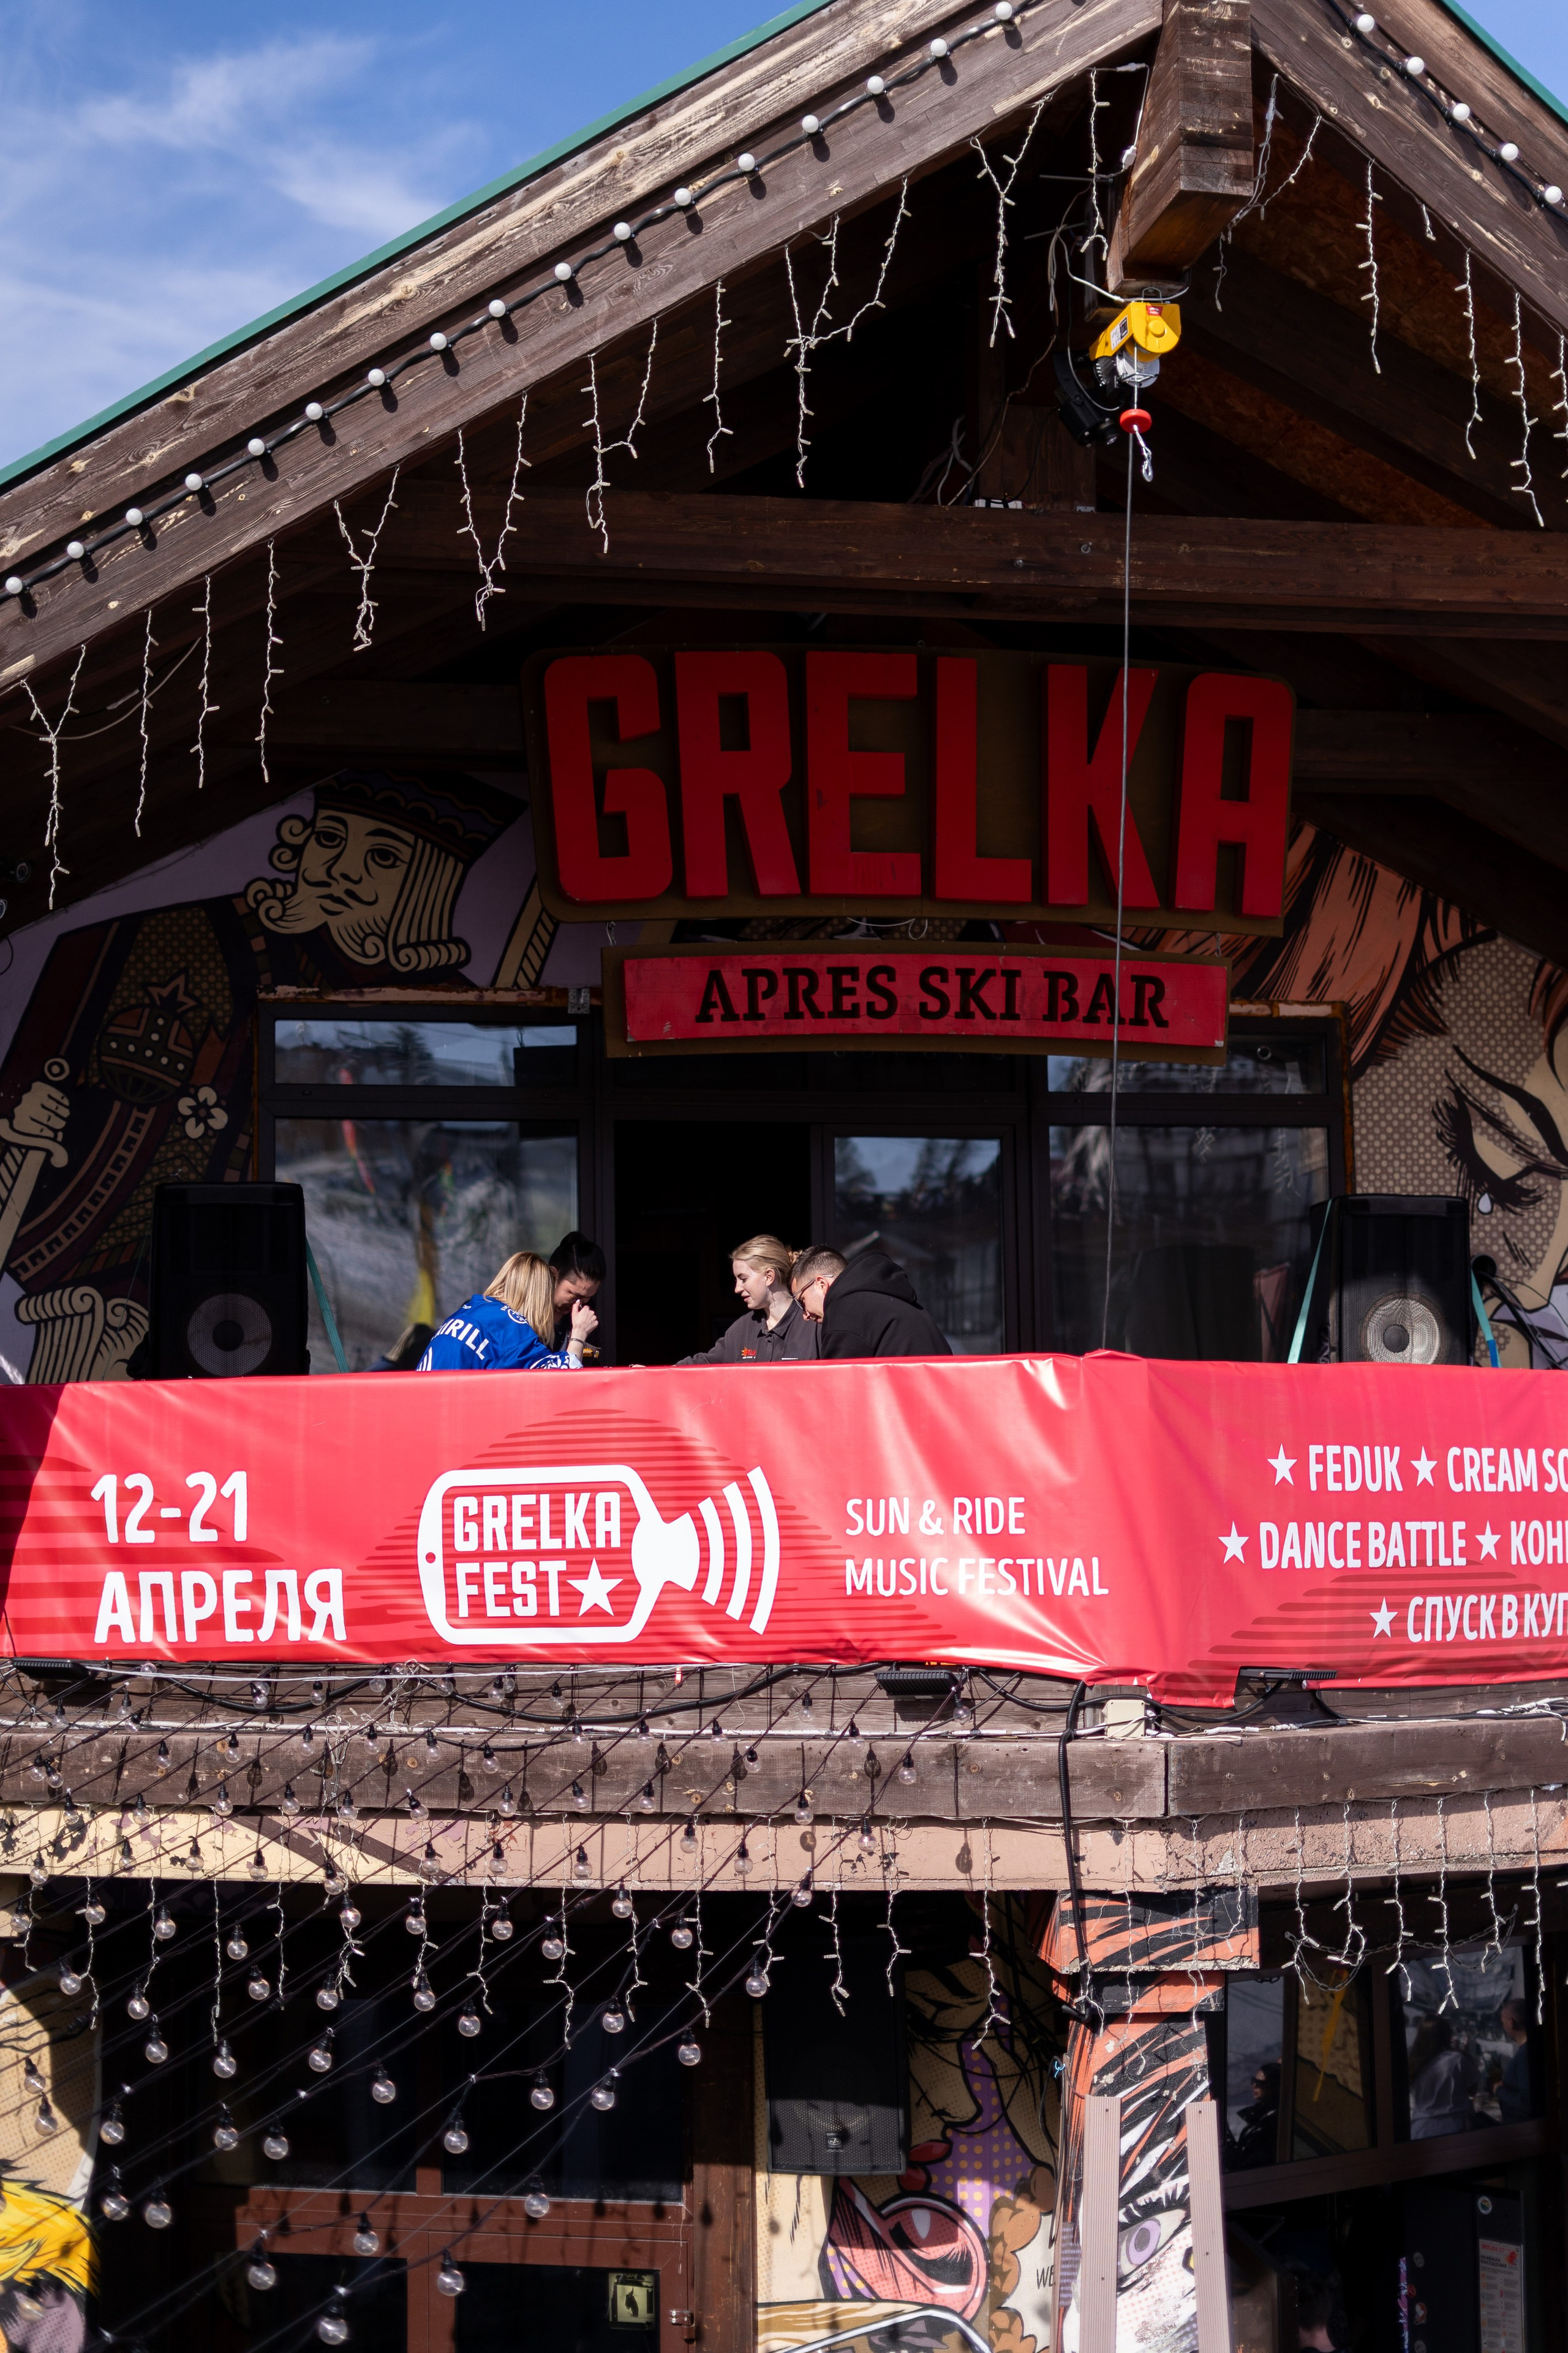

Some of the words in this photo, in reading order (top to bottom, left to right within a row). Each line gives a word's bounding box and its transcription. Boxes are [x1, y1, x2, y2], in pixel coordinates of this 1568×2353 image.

[544, 651, 1292, 918] GRELKA
[695, 966, 899, 1023] APRES
[919, 967, 1021, 1021] SKI
[1043, 971, 1169, 1028] BAR
[1309, 1445, 1403, 1492] FEDUK
[1447, 1447, 1538, 1492] CREAM
[91, 1471, 247, 1544] 12-21
[454, 1492, 621, 1552] GRELKA
[845, 1497, 910, 1536] SUN
[919, 1498, 944, 1535] &
[953, 1497, 1026, 1535] RIDE
[1259, 1521, 1361, 1569] DANCE
[1368, 1521, 1466, 1568] BATTLE
[1510, 1520, 1568, 1565] КОН
[456, 1560, 567, 1618] FEST
[845, 1557, 948, 1597] MUSIC
[959, 1557, 1109, 1596] FESTIVAL
[94, 1568, 347, 1644] АПРЕЛЯ
[1407, 1595, 1496, 1642] СПУСК
[1502, 1594, 1518, 1639] В
